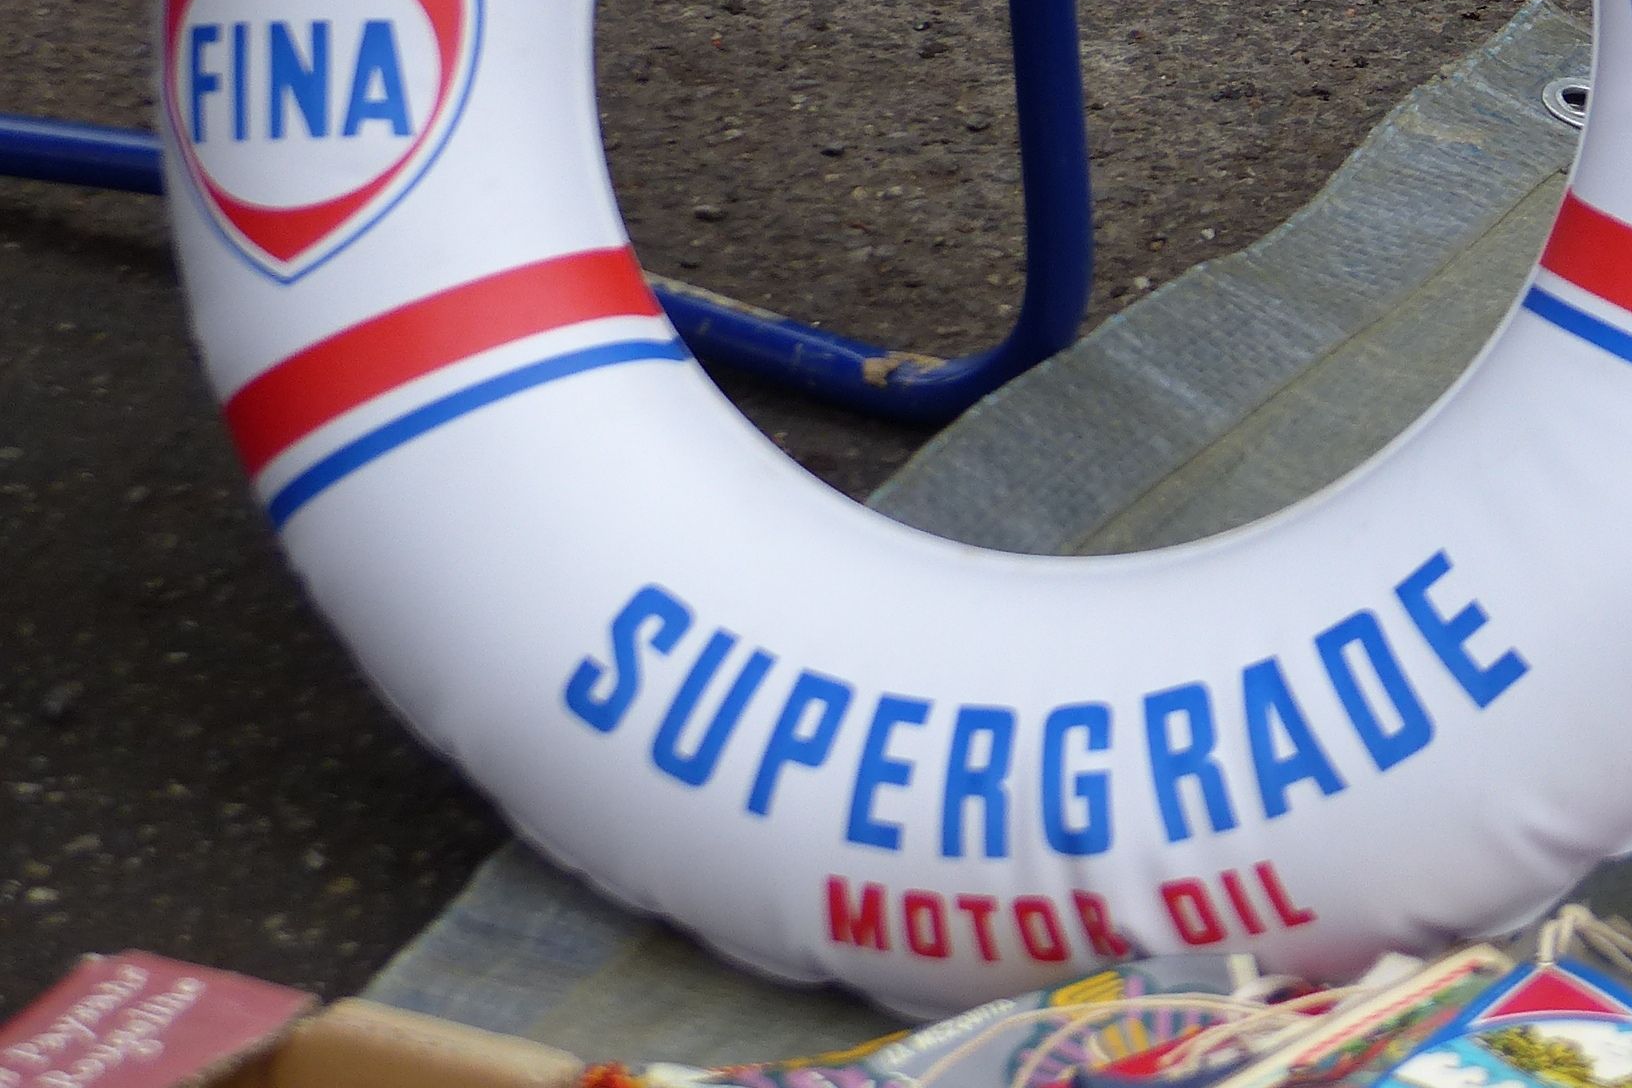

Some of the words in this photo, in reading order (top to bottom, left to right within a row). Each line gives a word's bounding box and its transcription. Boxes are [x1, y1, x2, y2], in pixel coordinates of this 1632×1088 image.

[187, 17, 416, 145] FINA
[561, 549, 1532, 861] SUPERGRADE
[824, 875, 1132, 965] MOTOR
[1159, 862, 1316, 948] OIL
